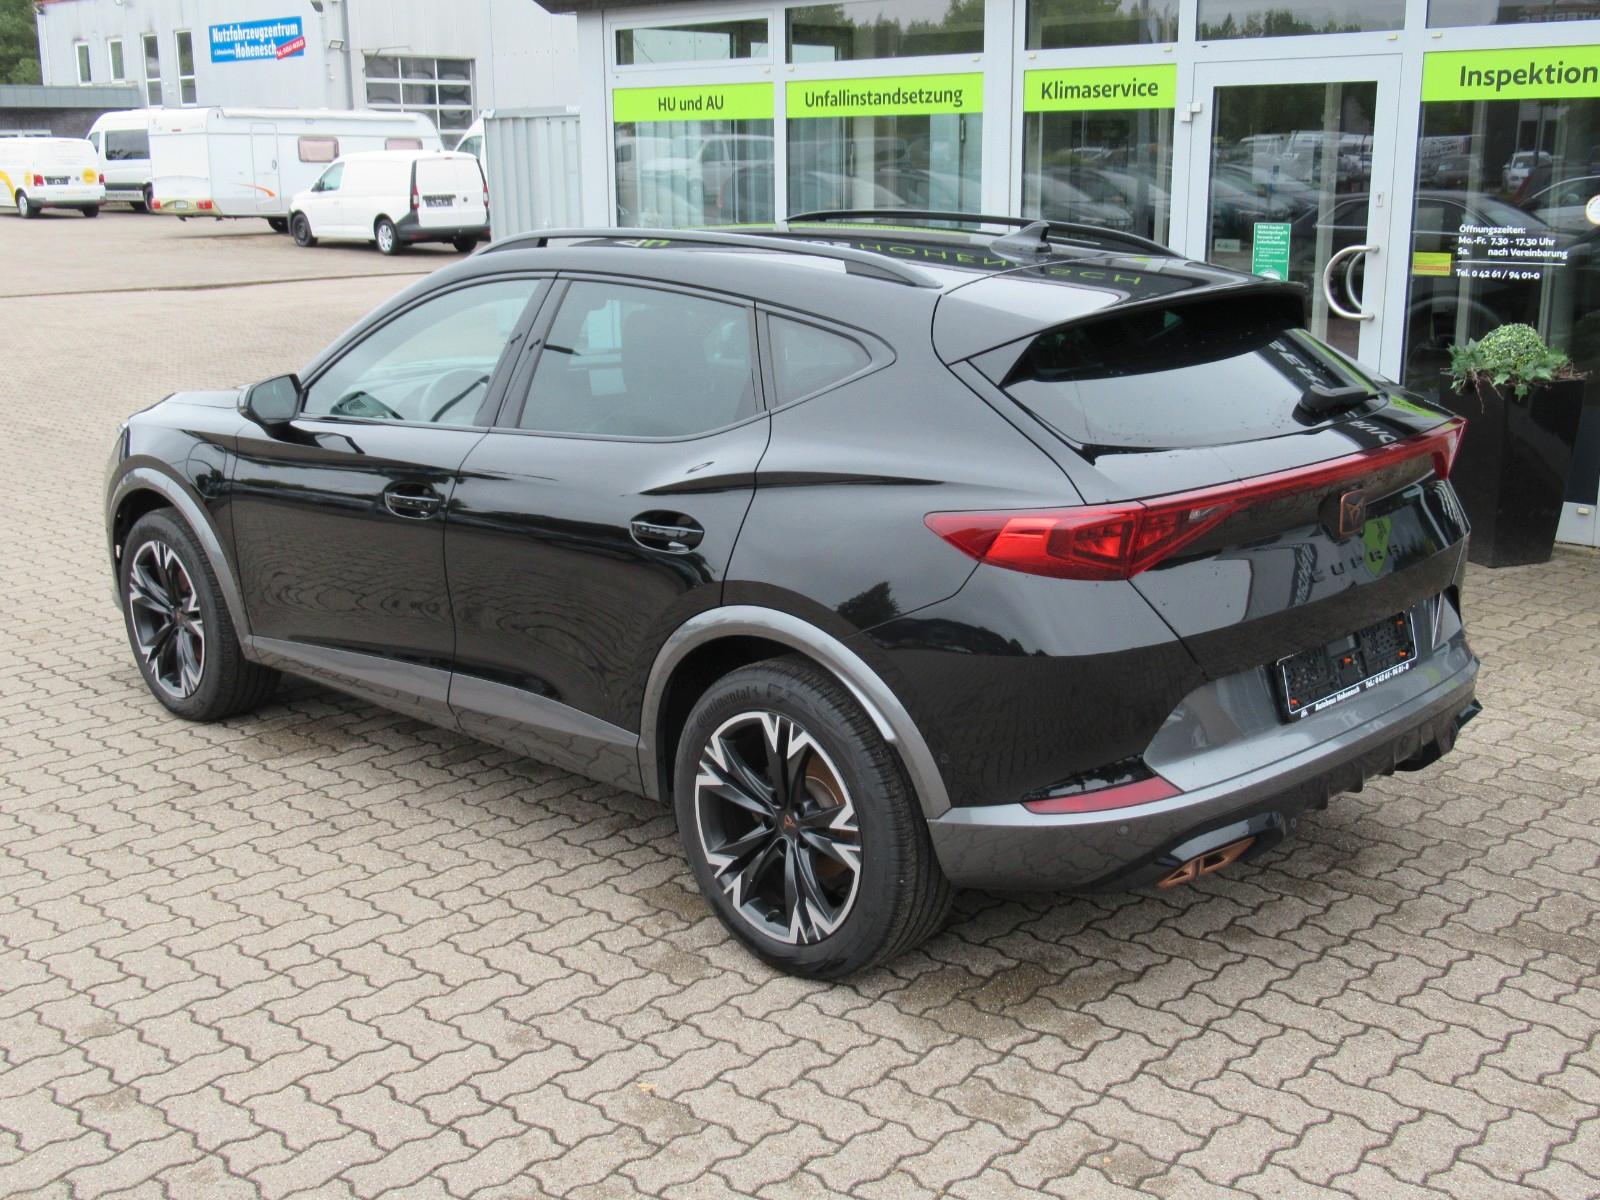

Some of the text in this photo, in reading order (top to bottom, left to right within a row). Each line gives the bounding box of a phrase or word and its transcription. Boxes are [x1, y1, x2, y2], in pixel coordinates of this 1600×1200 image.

[212, 23, 299, 43] Nutzfahrzeugzentrum
[235, 40, 277, 58] Hohenesch
[1459, 60, 1599, 92] Inspektion
[805, 86, 963, 108] Unfallinstandsetzung
[1041, 77, 1159, 100] Klimaservice
[658, 95, 724, 112] HU und AU
[1459, 223, 1526, 235] Öffnungszeiten:
[1458, 236, 1487, 245] Mo.-Fr.
[1490, 237, 1508, 246] 7.30
[1515, 238, 1538, 247] 17.30
[1538, 238, 1555, 246] Uhr
[1457, 246, 1568, 260] Sa. nach Vereinbarung
[1456, 268, 1470, 277] Tel.
[1478, 270, 1490, 278] 42
[1491, 270, 1501, 278] 61
[1501, 270, 1508, 280] /
[1508, 271, 1520, 280] 94
